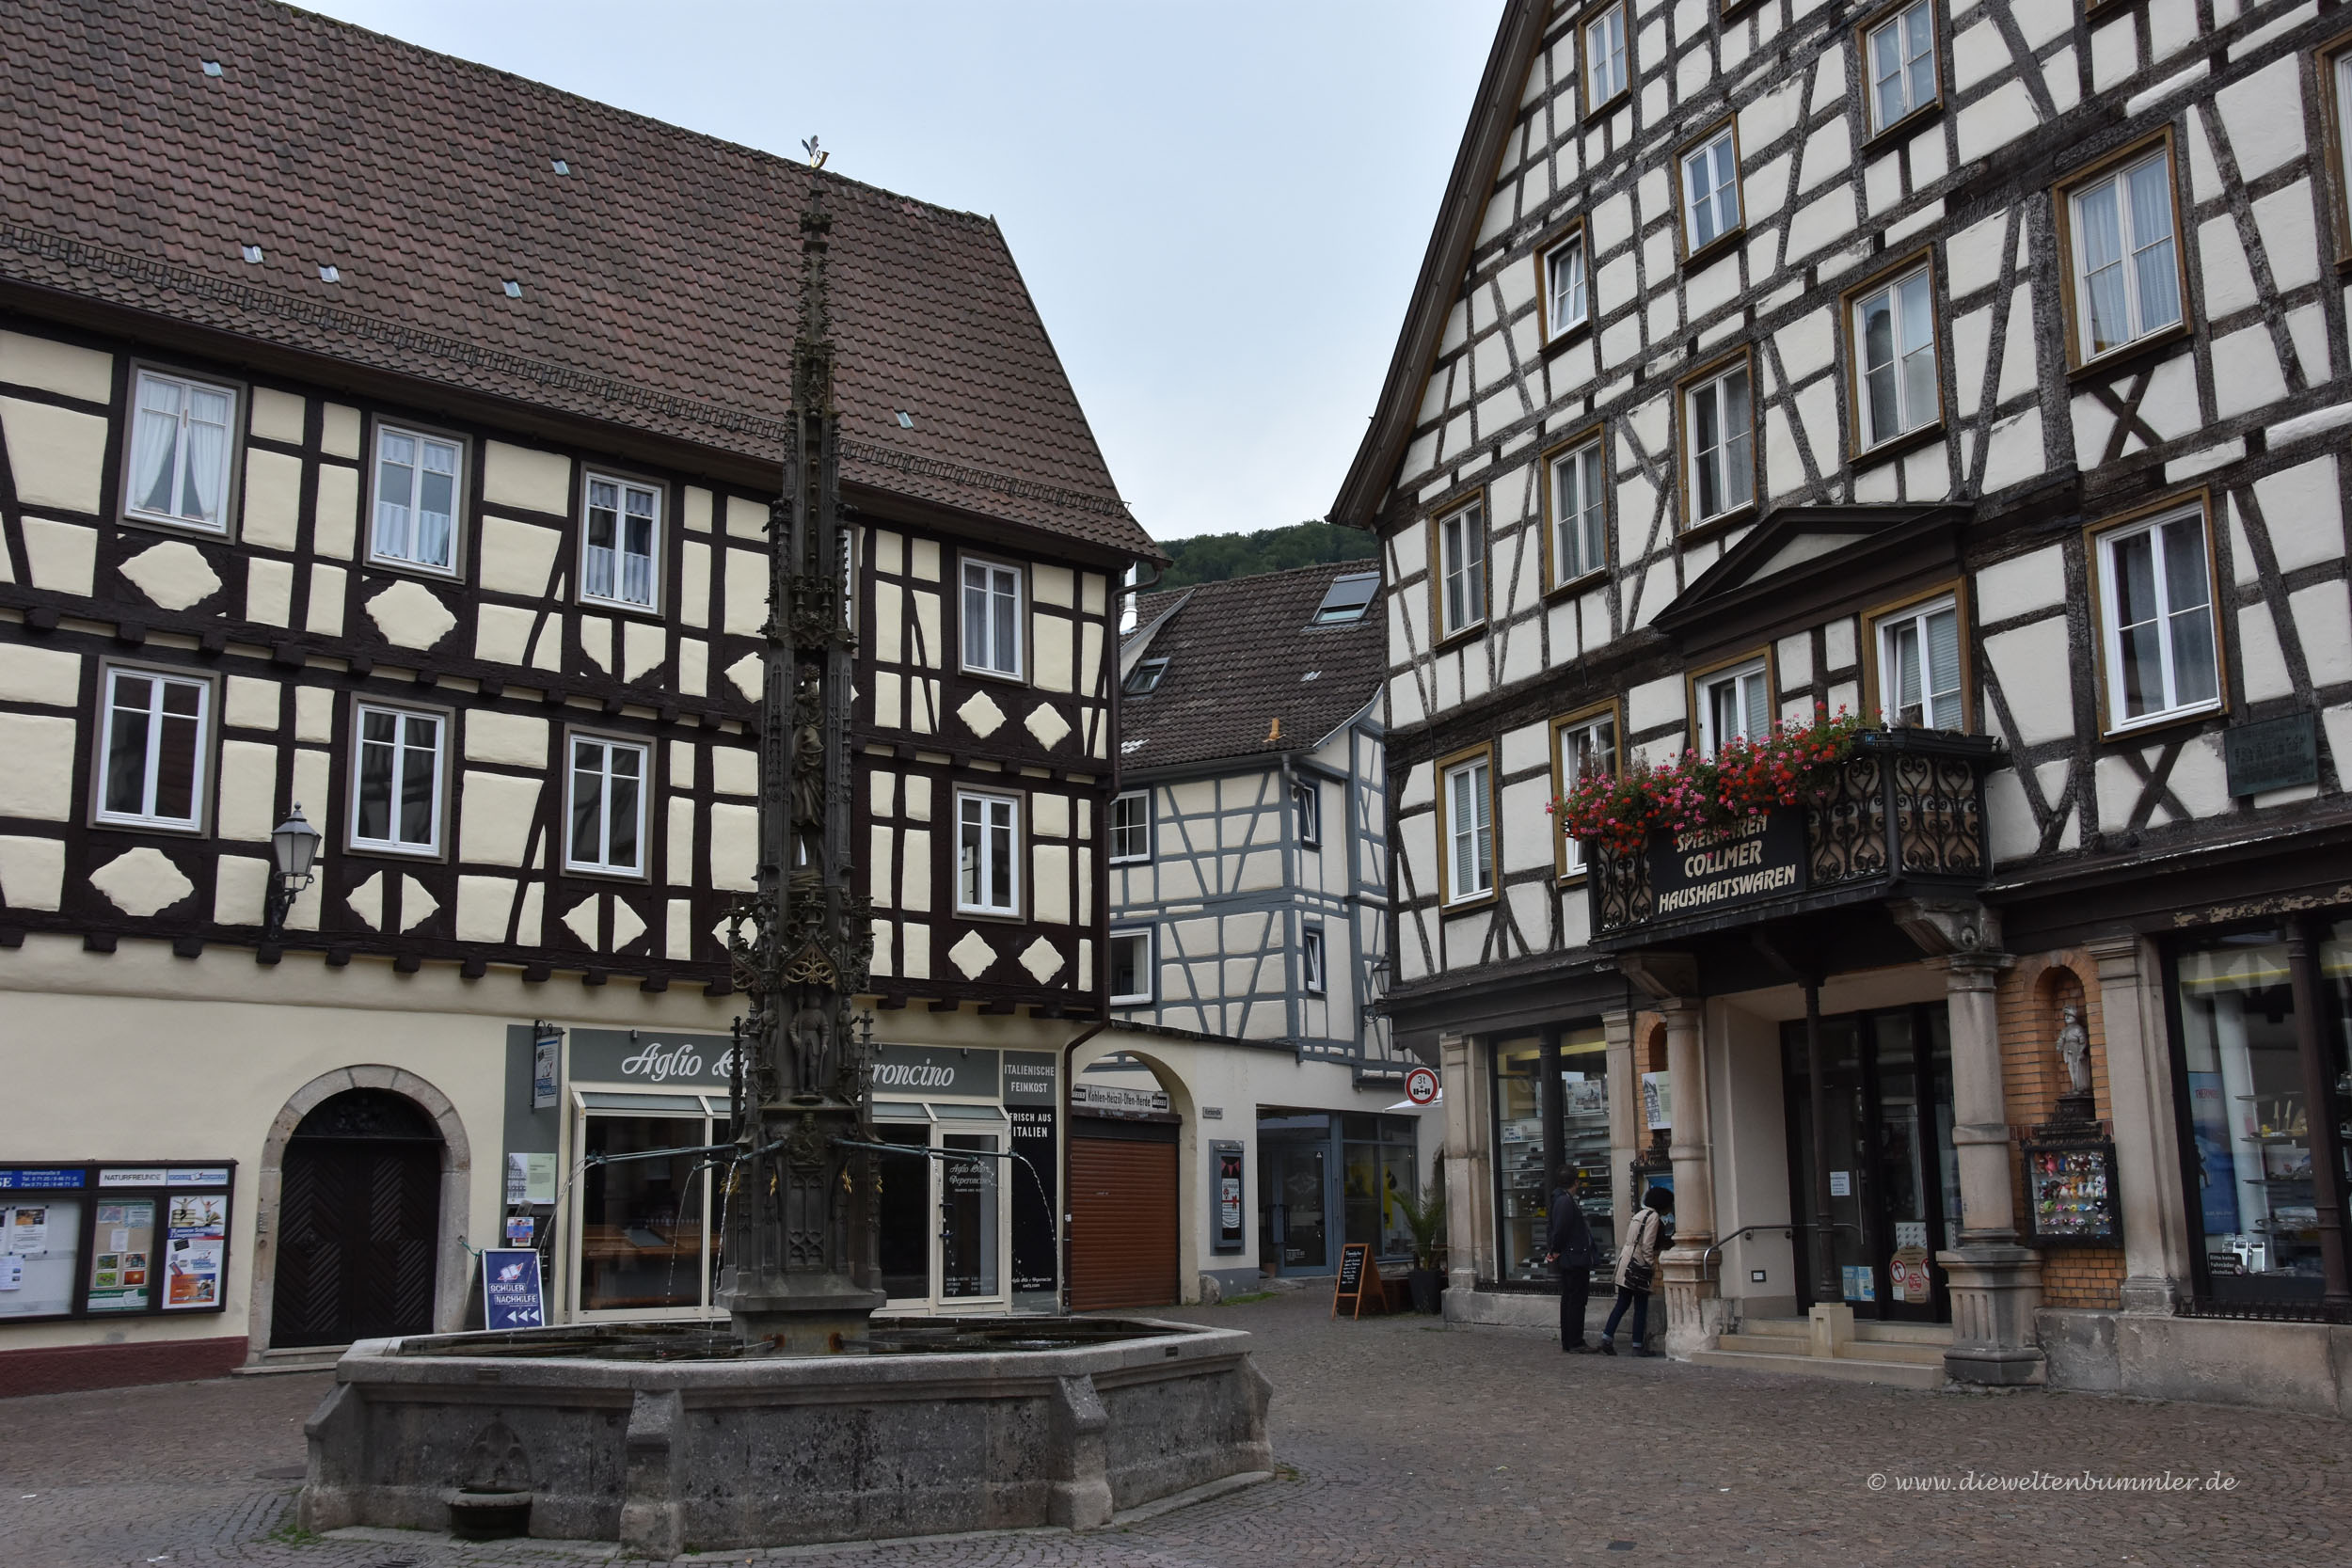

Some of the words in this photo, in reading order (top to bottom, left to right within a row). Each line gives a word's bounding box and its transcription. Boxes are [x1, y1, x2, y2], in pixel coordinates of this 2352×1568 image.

[1684, 840, 1762, 878] COLLMER
[1659, 863, 1797, 914] HAUSHALTSWAREN
[621, 1042, 703, 1082] Aglio
[1004, 1064, 1055, 1076] ITALIENISCHE
[1010, 1082, 1048, 1093] FEINKOST
[1009, 1112, 1035, 1122] FRISCH
[1038, 1113, 1052, 1122] AUS
[1013, 1126, 1048, 1138] ITALIEN
[490, 1284, 525, 1292] SCHÜLER
[496, 1295, 536, 1304] NACHHILFE
